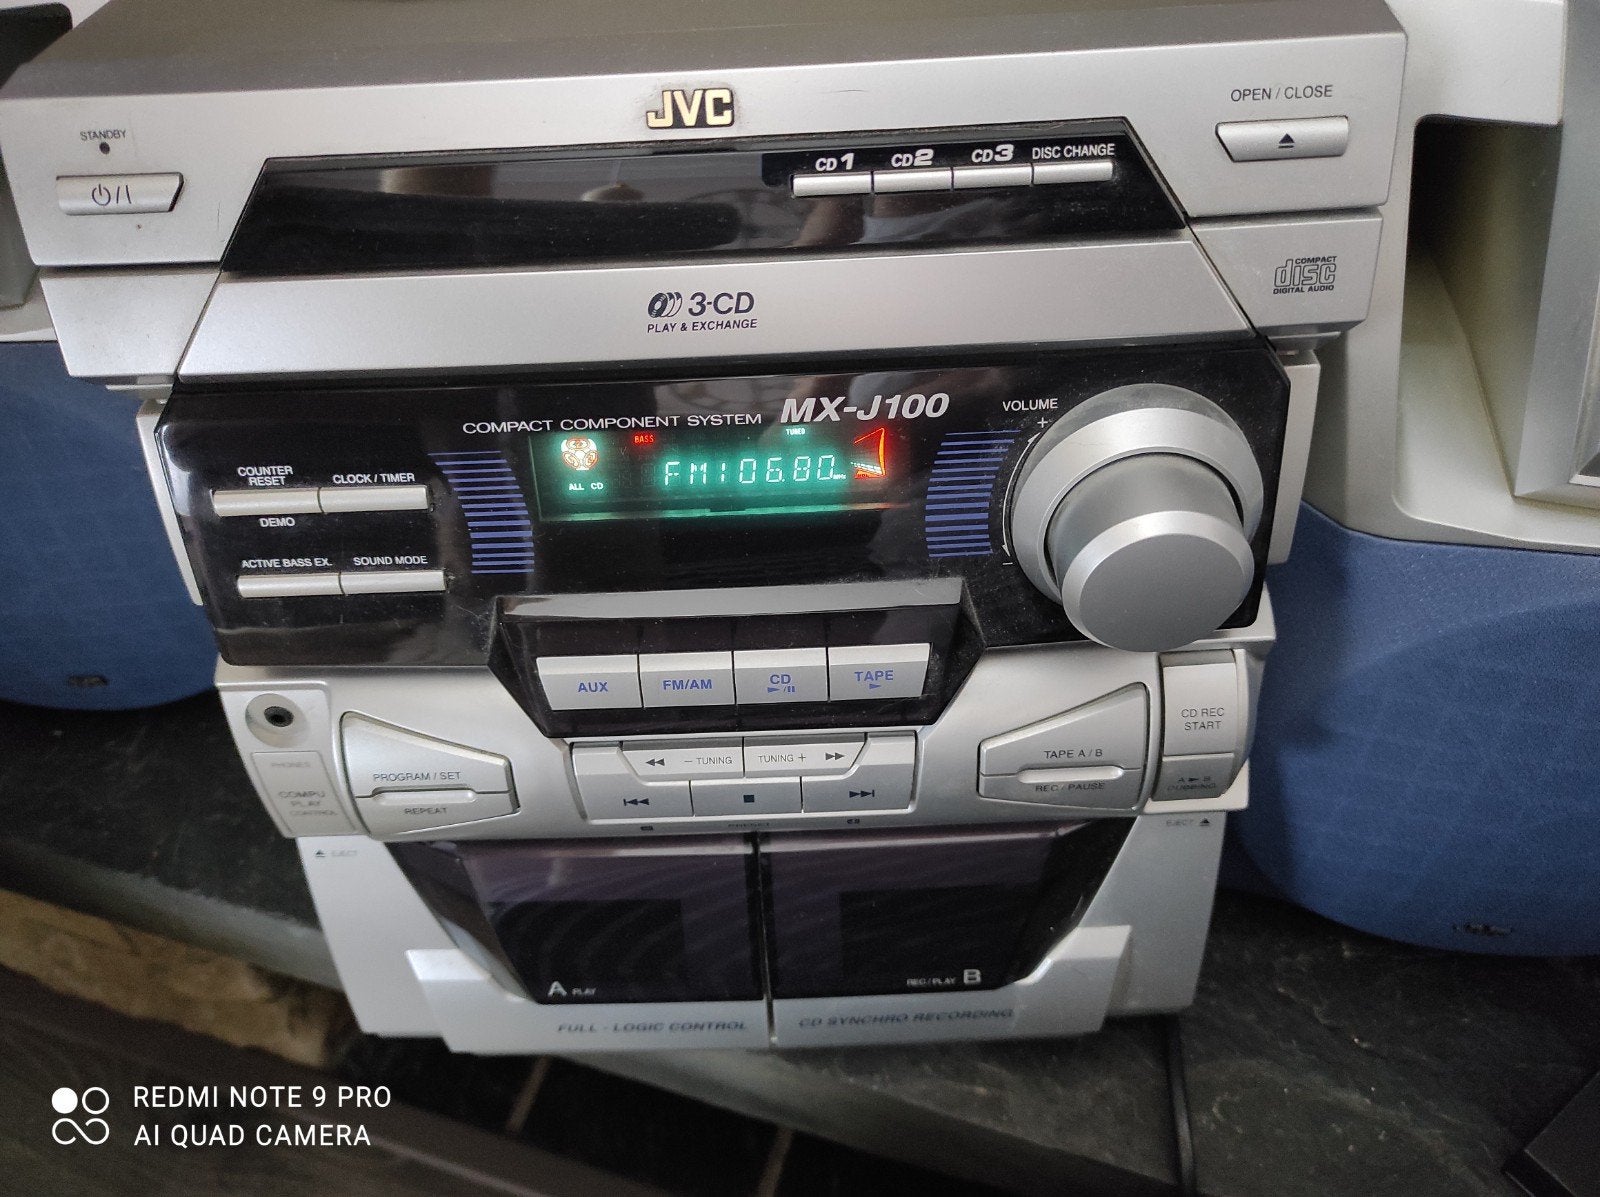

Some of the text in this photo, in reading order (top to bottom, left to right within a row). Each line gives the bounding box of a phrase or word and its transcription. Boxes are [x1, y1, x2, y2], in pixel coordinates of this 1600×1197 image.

[1231, 88, 1272, 102] OPEN
[1284, 85, 1333, 100] CLOSE
[646, 87, 734, 129] JVC
[80, 130, 126, 141] STANDBY
[1032, 143, 1115, 160] DISC CHANGE
[1295, 256, 1337, 264] COMPACT
[1274, 259, 1337, 288] disc
[1273, 285, 1334, 295] DIGITAL AUDIO
[688, 291, 755, 316] 3-CD
[647, 319, 758, 333] PLAY & EXCHANGE
[780, 393, 950, 423] MX-J100
[1002, 398, 1059, 412] VOLUME
[462, 413, 762, 435] COMPACT COMPONENT SYSTEM
[634, 435, 654, 444] BASS
[237, 465, 293, 477] COUNTER
[249, 476, 285, 486] RESET
[333, 474, 372, 484] CLOCK
[380, 473, 415, 483] TIMER
[568, 482, 604, 491] ALL CD
[259, 517, 295, 528] DEMO
[241, 557, 332, 569] ACTIVE BASS EX.
[353, 555, 428, 566] SOUND MODE
[770, 673, 791, 685] CD
[854, 670, 894, 682] TAPE
[577, 682, 608, 693] AUX
[662, 678, 712, 690] FM/AM
[1181, 707, 1225, 718] CD REC
[1184, 721, 1222, 731] START
[758, 753, 794, 763] TUNING
[1044, 750, 1074, 759] TAPE
[1076, 750, 1086, 758] A
[1096, 748, 1103, 757] B
[696, 756, 733, 766] TUNING
[373, 772, 431, 782] PROGRAM
[440, 771, 462, 780] SET
[1035, 784, 1059, 793] REC
[1068, 782, 1105, 792] PAUSE
[404, 806, 449, 815] REPEAT
[963, 968, 981, 985] B
[548, 980, 568, 997] A
[613, 1022, 664, 1033] LOGIC
[669, 1021, 747, 1032] CONTROL
